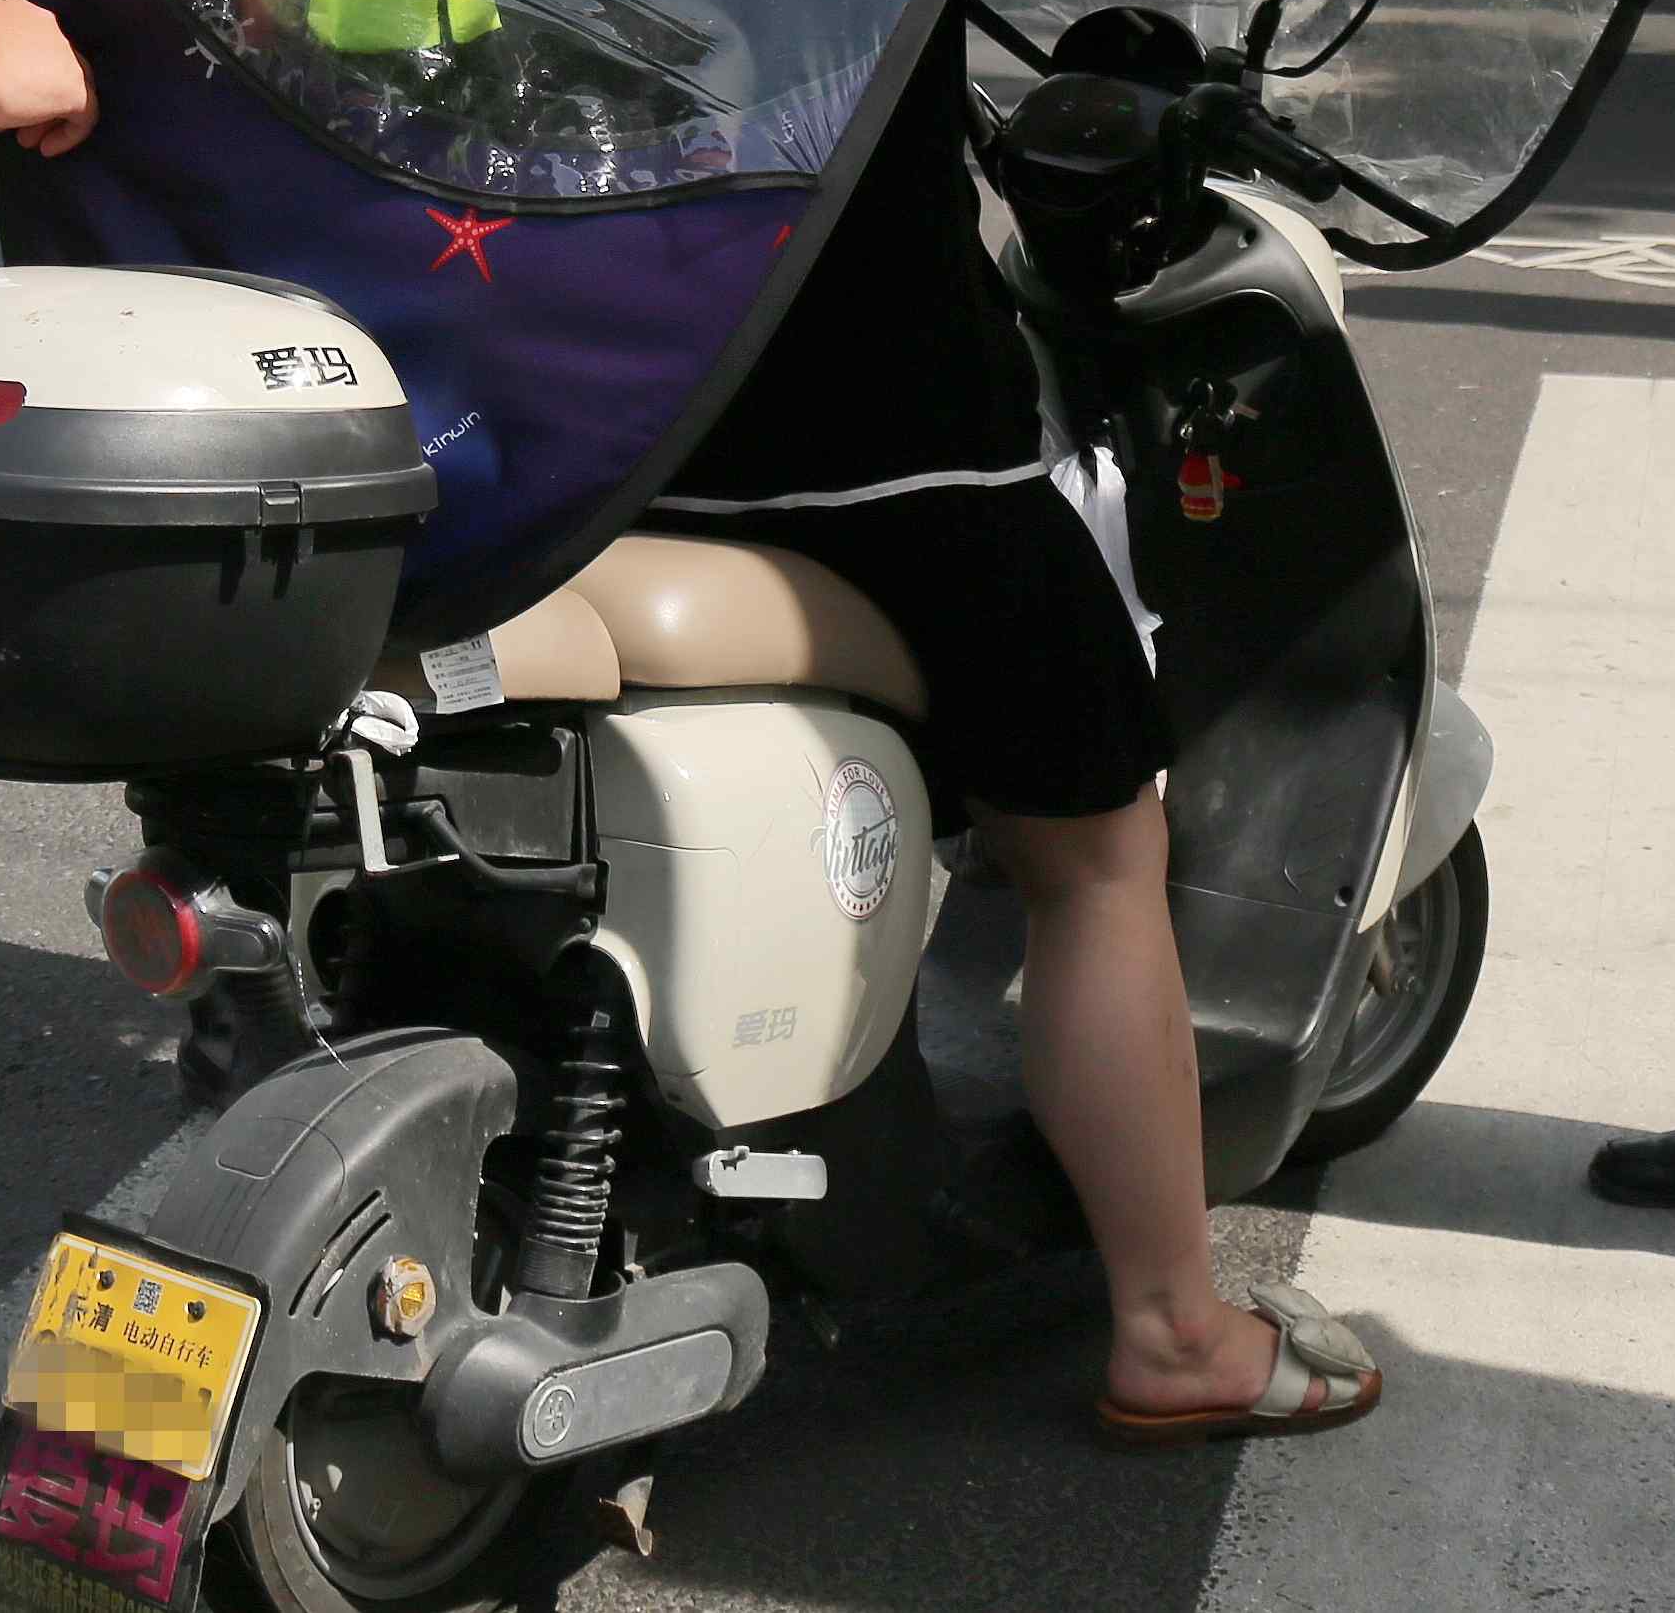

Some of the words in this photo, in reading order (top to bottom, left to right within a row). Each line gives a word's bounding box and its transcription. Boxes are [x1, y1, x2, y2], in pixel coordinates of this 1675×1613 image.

[251, 345, 358, 390] 爱玛
[422, 411, 481, 457] kinwin
[842, 766, 861, 786] FOR
[732, 1005, 799, 1049] 爱玛
[123, 1320, 214, 1370] 电动自行车
